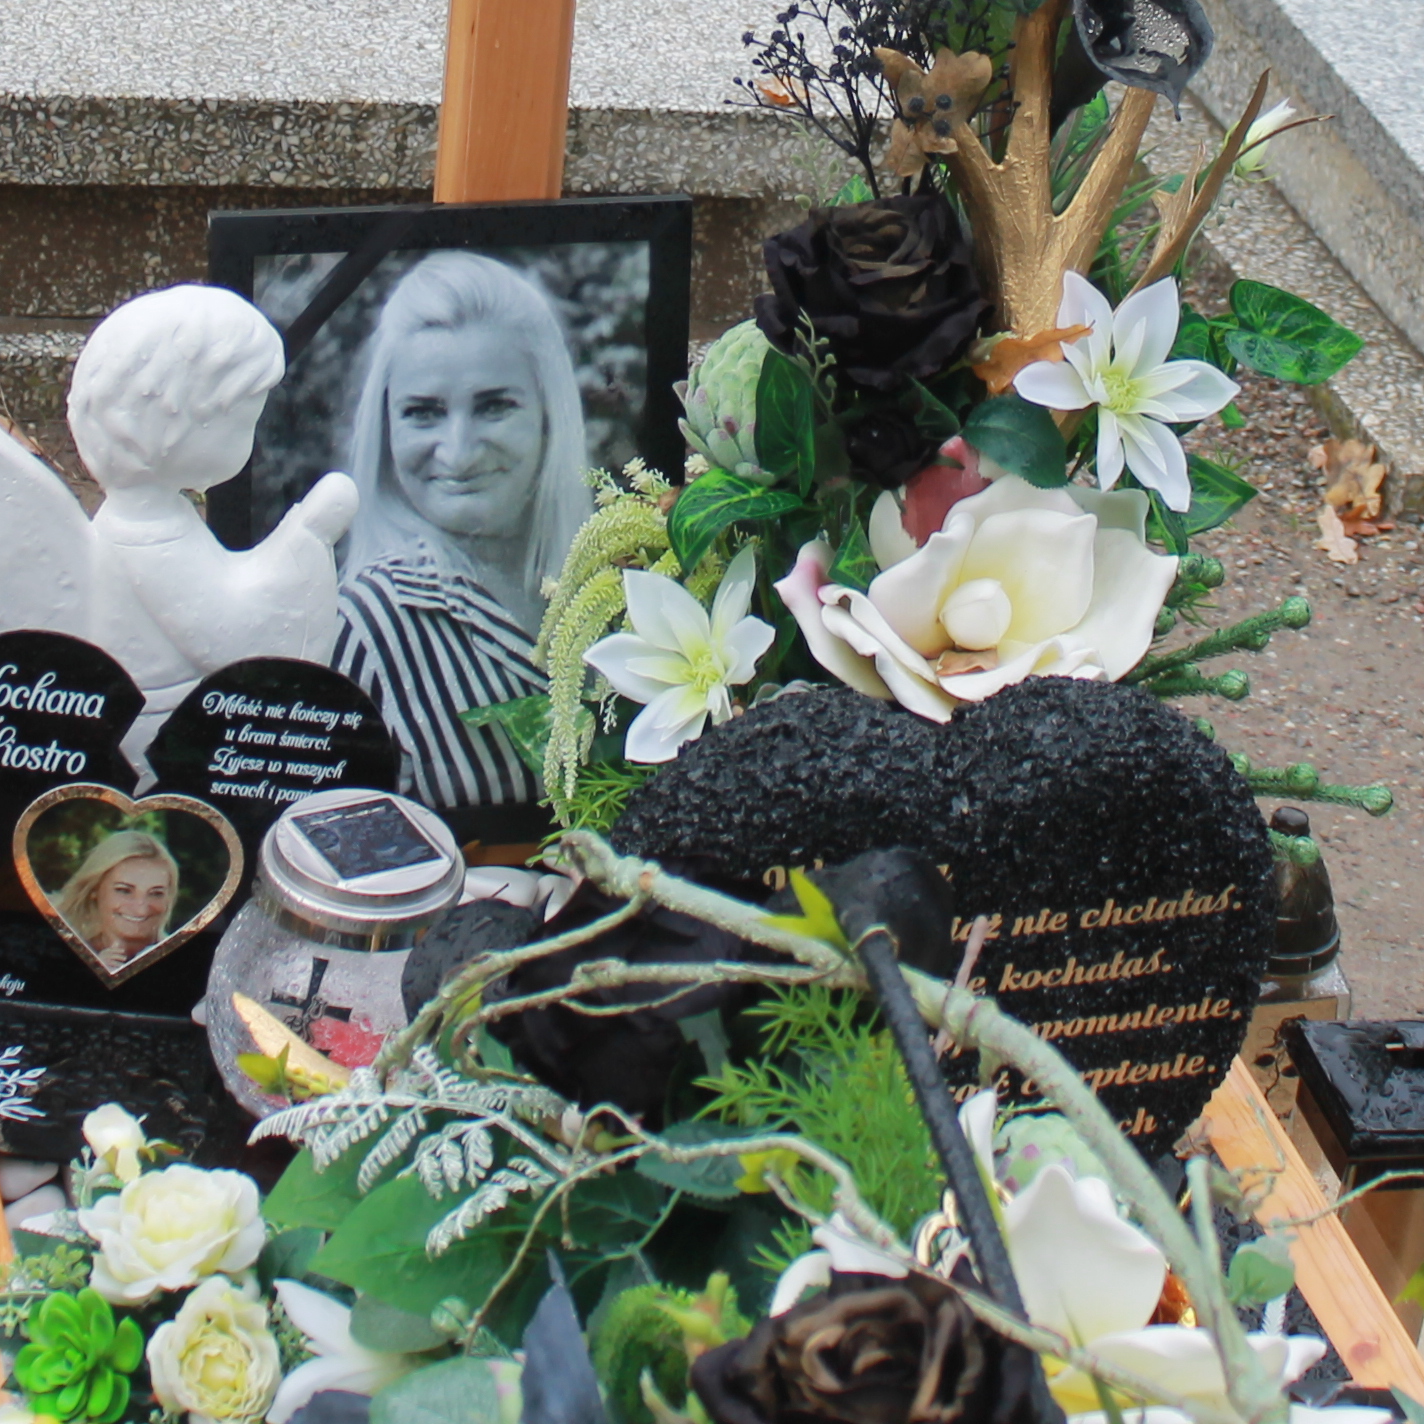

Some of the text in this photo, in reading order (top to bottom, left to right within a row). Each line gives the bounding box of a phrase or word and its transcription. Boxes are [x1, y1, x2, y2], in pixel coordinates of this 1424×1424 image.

[202, 691, 363, 732] Miłość nie kończy się
[224, 723, 332, 752] u bram śmierci.
[208, 745, 348, 785] Żyjesz w naszych
[210, 779, 270, 799] sercach
[274, 786, 316, 805] pami
[1012, 907, 1070, 938] nie
[1079, 883, 1243, 931] chciałaś.
[998, 947, 1174, 994] kochałaś.
[1032, 996, 1242, 1043] pomnienie,
